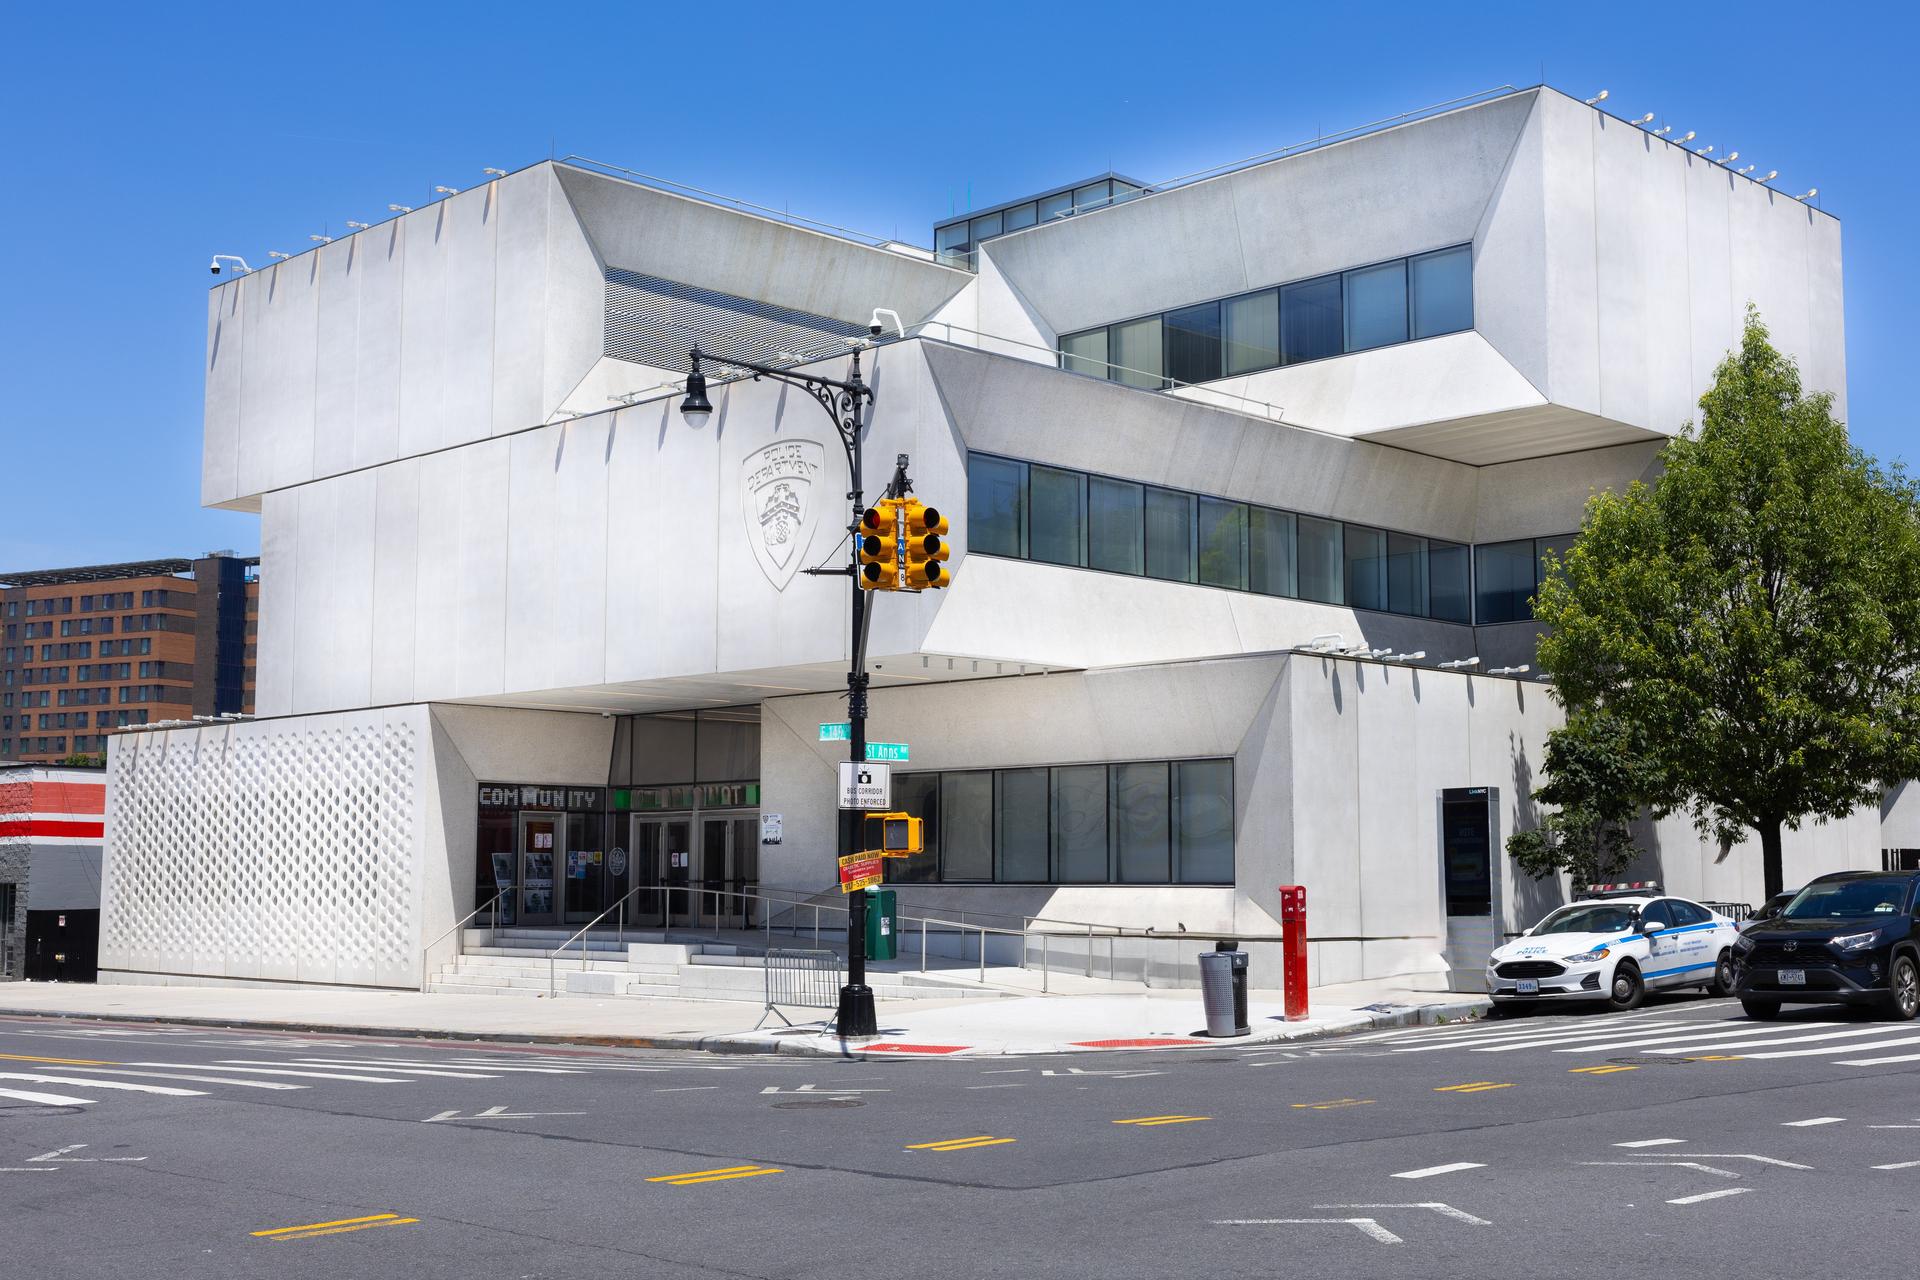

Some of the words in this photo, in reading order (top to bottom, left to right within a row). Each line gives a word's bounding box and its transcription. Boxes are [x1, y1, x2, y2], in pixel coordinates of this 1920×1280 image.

[763, 445, 802, 461] POLICE
[748, 460, 818, 490] DEPARTMENT
[867, 745, 875, 758] St
[878, 745, 898, 759] Anns
[480, 787, 596, 807] COMMUNITY
[847, 787, 857, 795] BUS
[859, 787, 883, 795] CORRIDOR
[843, 797, 859, 805] PHOTO
[861, 798, 886, 806] ENFORCED
[842, 856, 854, 865] CASH
[854, 854, 867, 862] PAID
[867, 851, 880, 859] NOW
